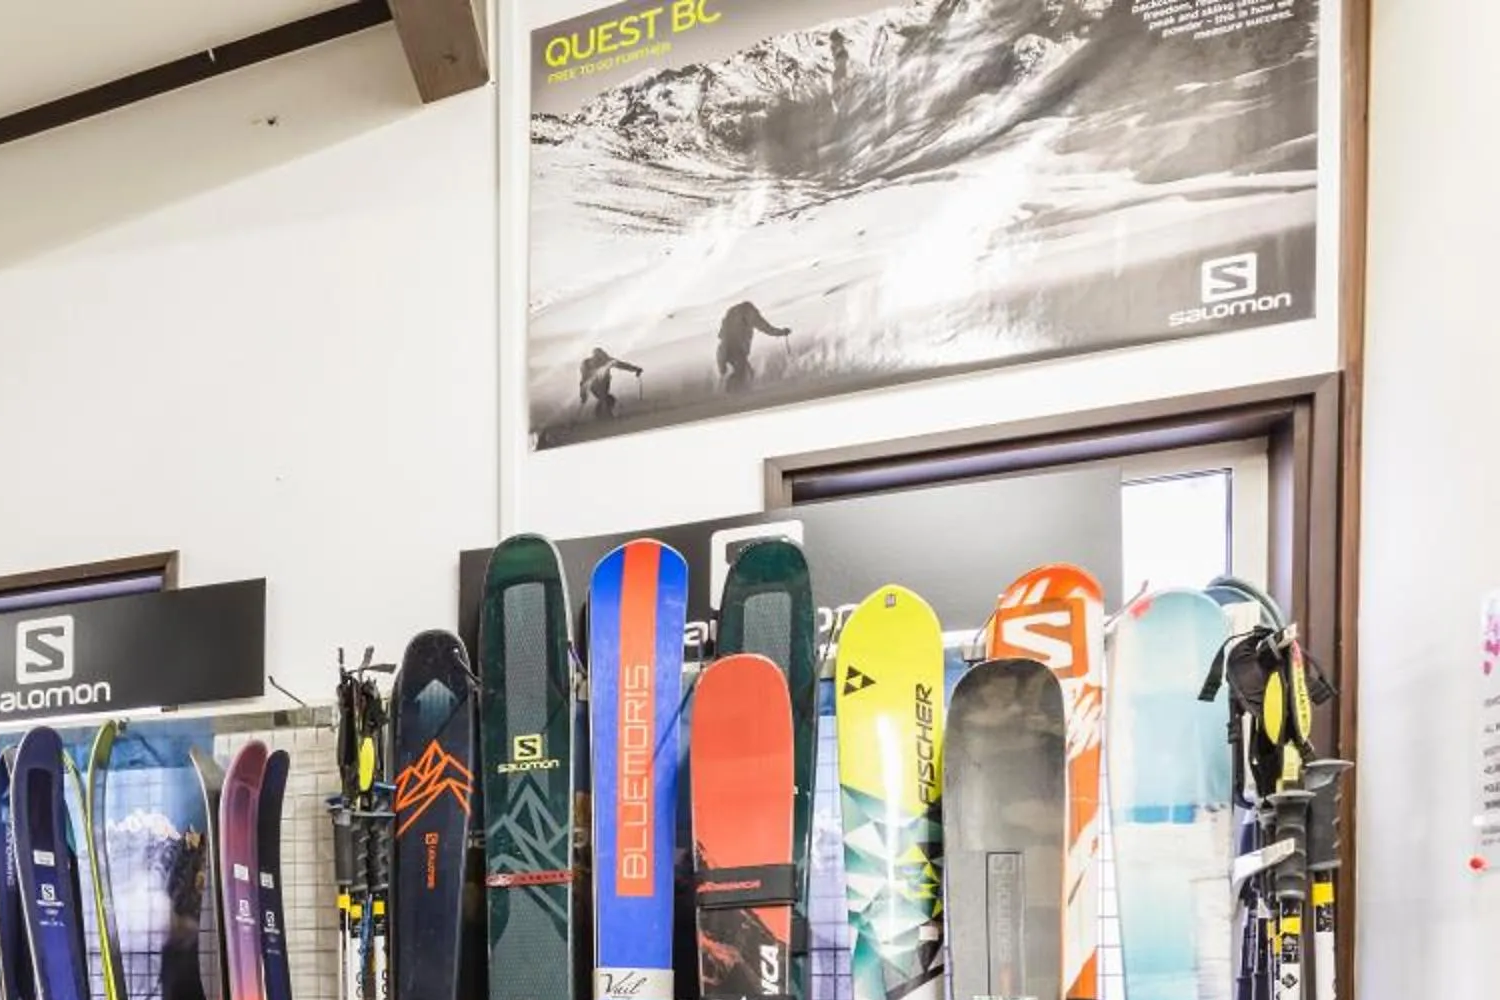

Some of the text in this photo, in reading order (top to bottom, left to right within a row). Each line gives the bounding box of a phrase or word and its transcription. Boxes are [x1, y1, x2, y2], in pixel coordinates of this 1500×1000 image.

[546, 0, 722, 67] QUEST BC
[548, 68, 576, 84] FREE
[581, 63, 596, 75] TO
[615, 43, 673, 66] FURTHER
[1168, 292, 1293, 328] salomon
[497, 759, 561, 774] salomon
[917, 682, 934, 804] FISCHER
[623, 664, 650, 880] BLUEMORIS
